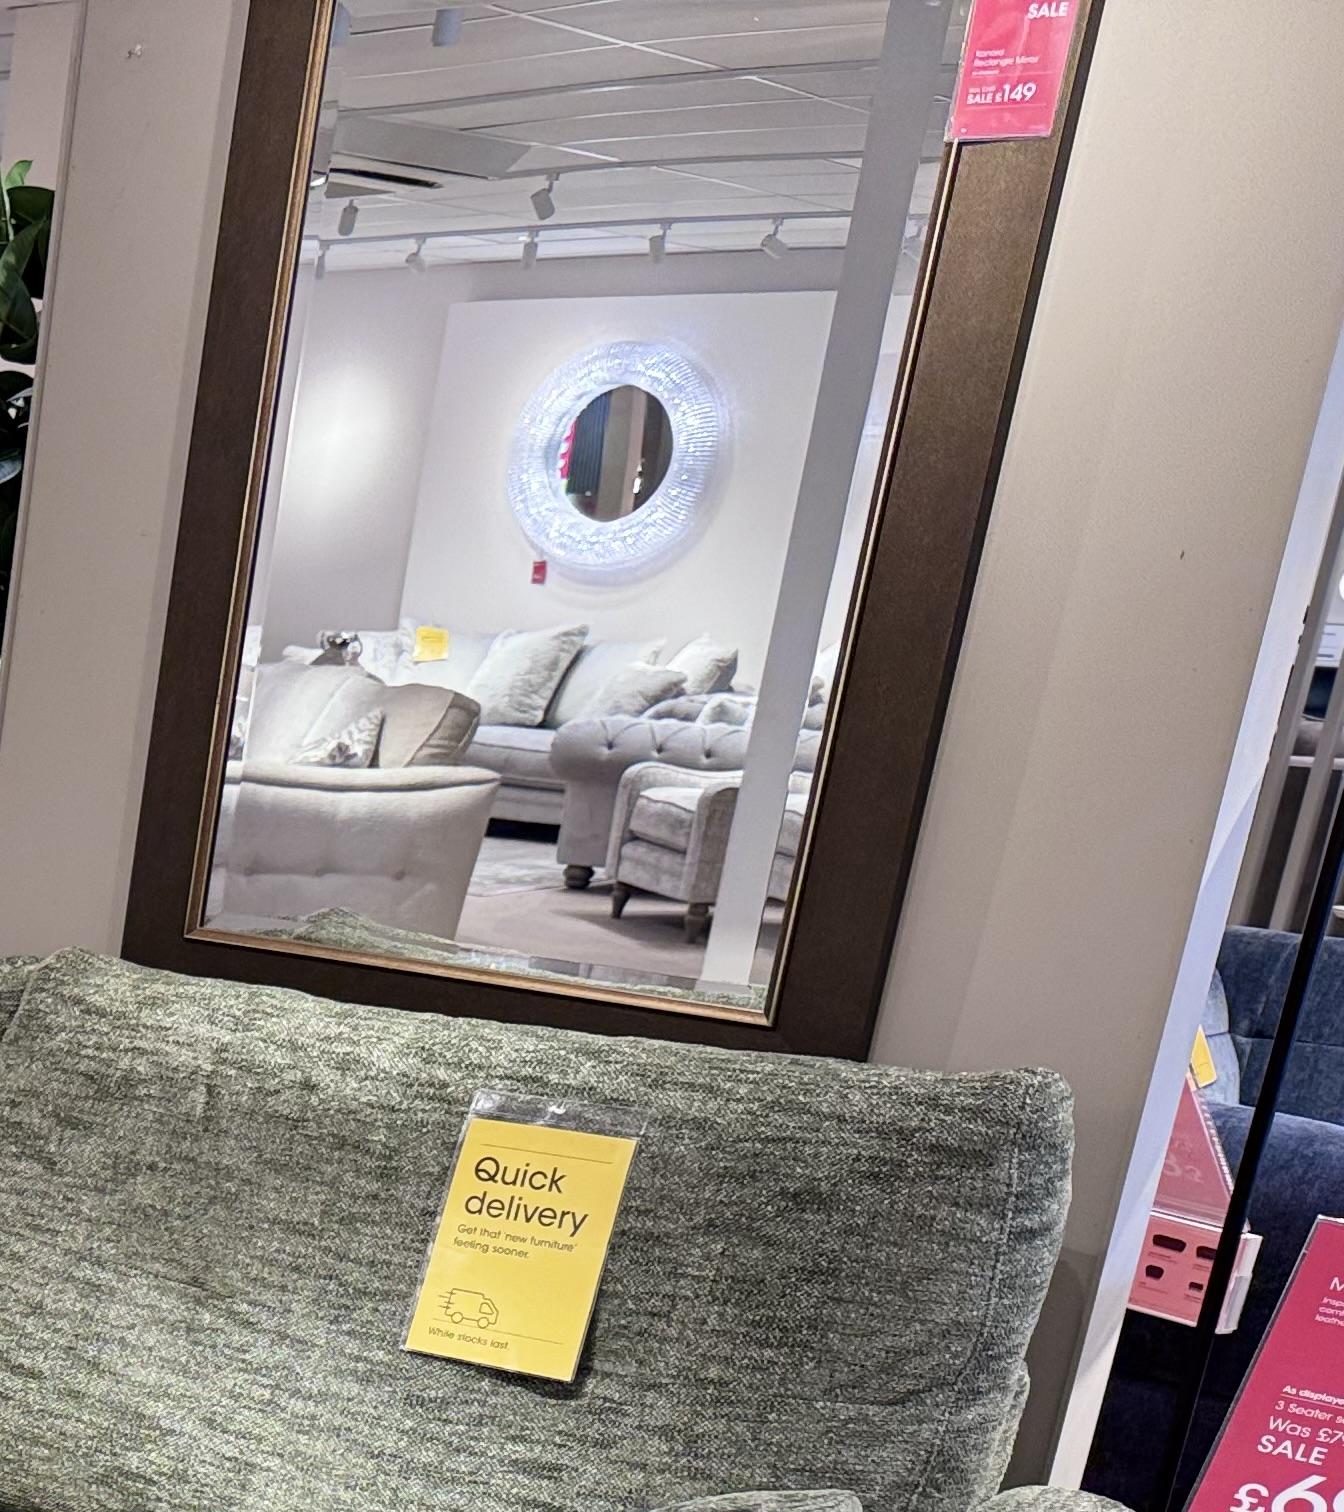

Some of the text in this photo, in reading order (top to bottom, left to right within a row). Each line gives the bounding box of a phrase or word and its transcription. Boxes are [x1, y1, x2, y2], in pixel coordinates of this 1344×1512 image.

[1028, 2, 1070, 19] SALE
[967, 93, 993, 104] SALE
[994, 82, 1037, 103] £149
[474, 1156, 567, 1194] Quick
[464, 1191, 589, 1237] delivery
[457, 1224, 478, 1235] Get
[479, 1228, 501, 1239] that
[453, 1237, 489, 1254] feeling
[428, 1326, 455, 1339] While
[457, 1334, 488, 1346] stocks
[1282, 1385, 1297, 1395] As
[1275, 1400, 1285, 1411] 3
[1288, 1403, 1333, 1422] Seater
[1269, 1415, 1312, 1438] Was
[1257, 1435, 1329, 1466] SALE
